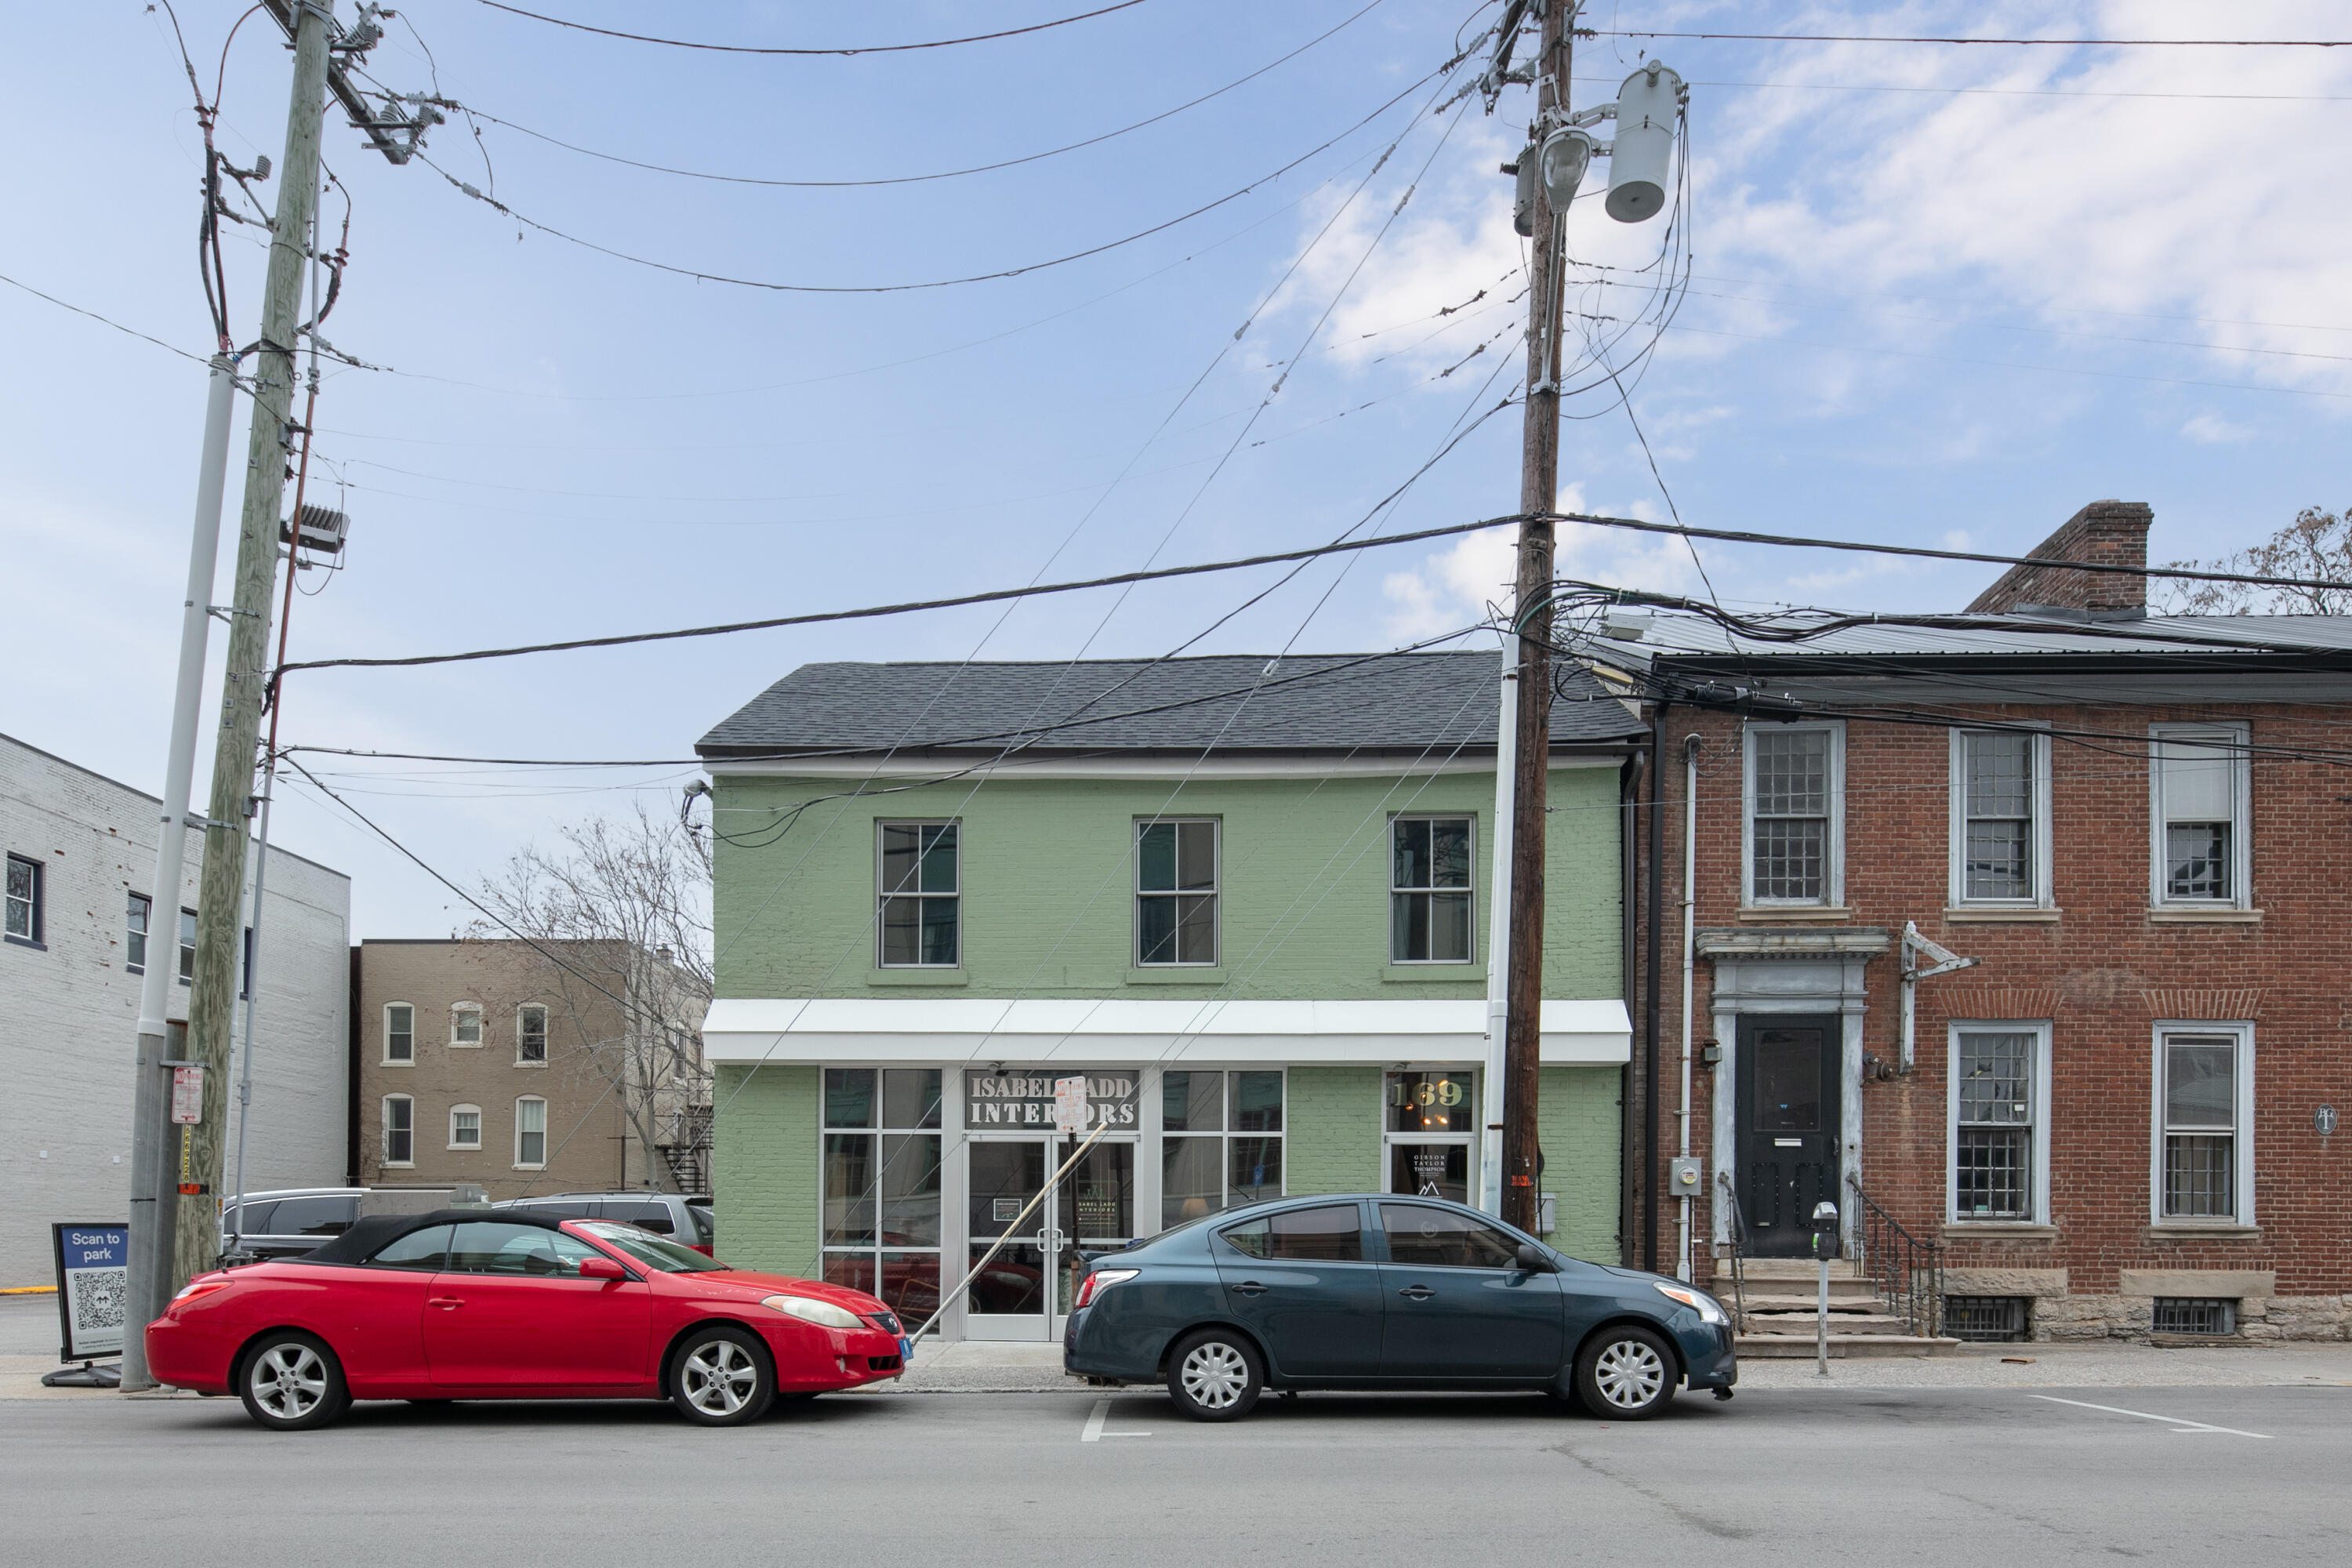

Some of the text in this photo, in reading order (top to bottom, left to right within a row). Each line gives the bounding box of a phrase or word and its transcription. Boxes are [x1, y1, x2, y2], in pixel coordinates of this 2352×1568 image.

[971, 1078, 1132, 1098] ISABEL ADD
[1393, 1082, 1463, 1106] 169
[971, 1102, 1134, 1123] INTERRS
[71, 1232, 120, 1245] Scan to
[83, 1247, 112, 1263] park
